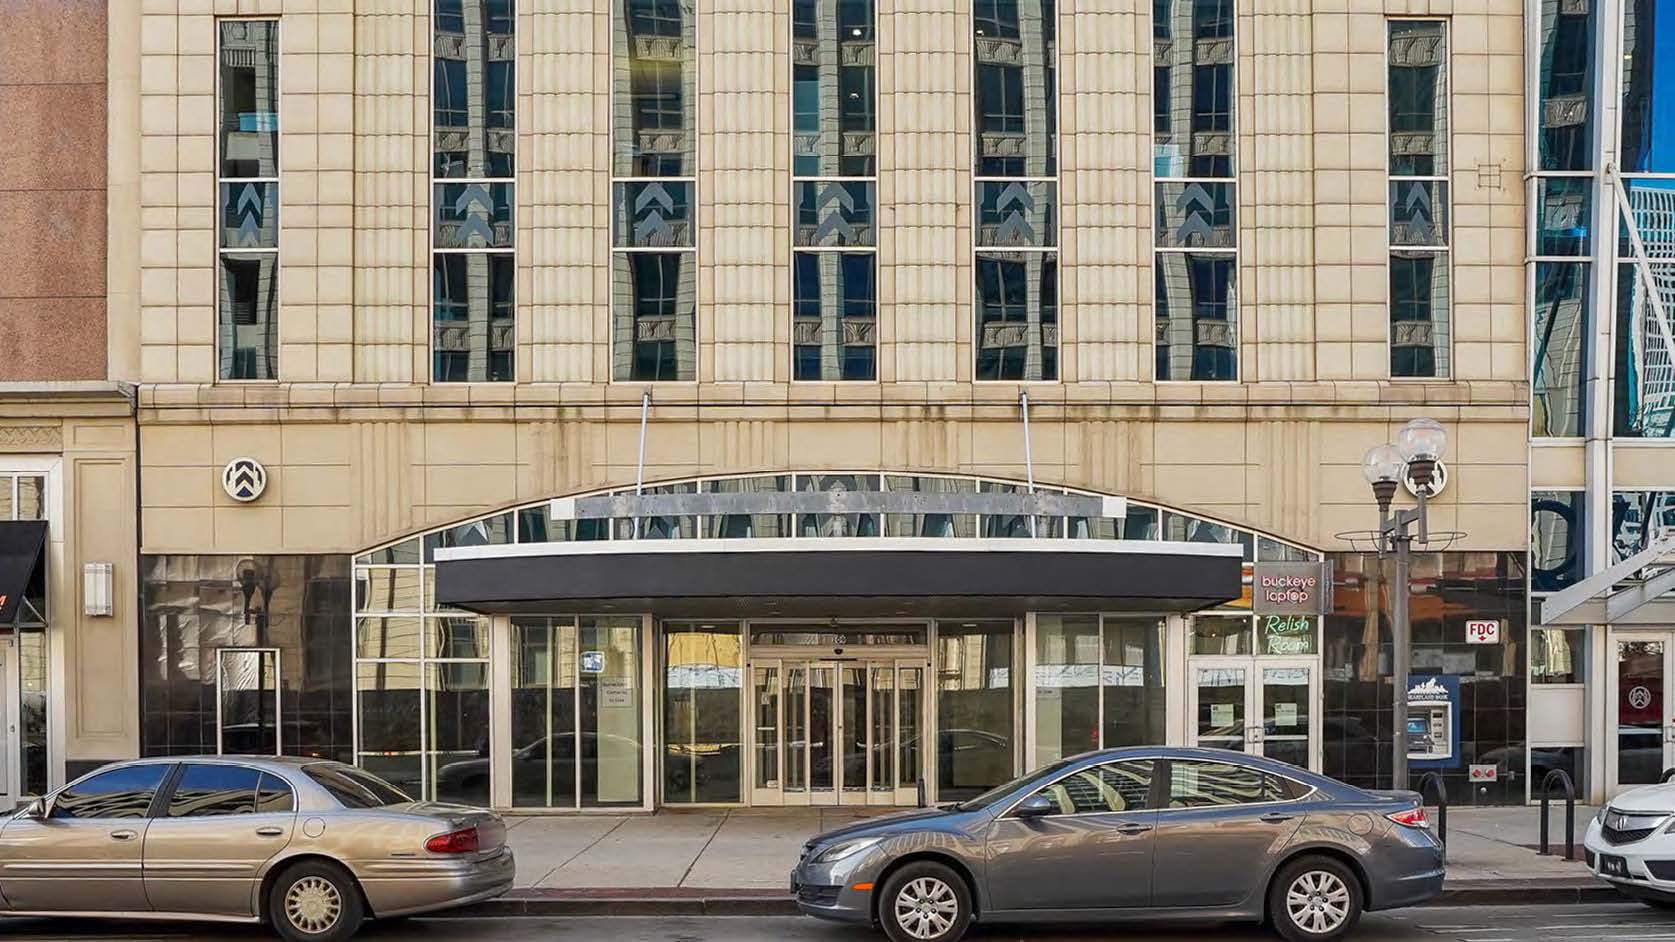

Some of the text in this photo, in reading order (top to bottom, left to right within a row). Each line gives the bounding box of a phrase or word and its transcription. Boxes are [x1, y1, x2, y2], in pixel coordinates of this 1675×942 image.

[1262, 576, 1316, 588] buckeye
[1266, 590, 1308, 602] laptop
[1265, 615, 1309, 634] Relish
[1470, 624, 1495, 635] FDC
[1267, 635, 1309, 654] Room
